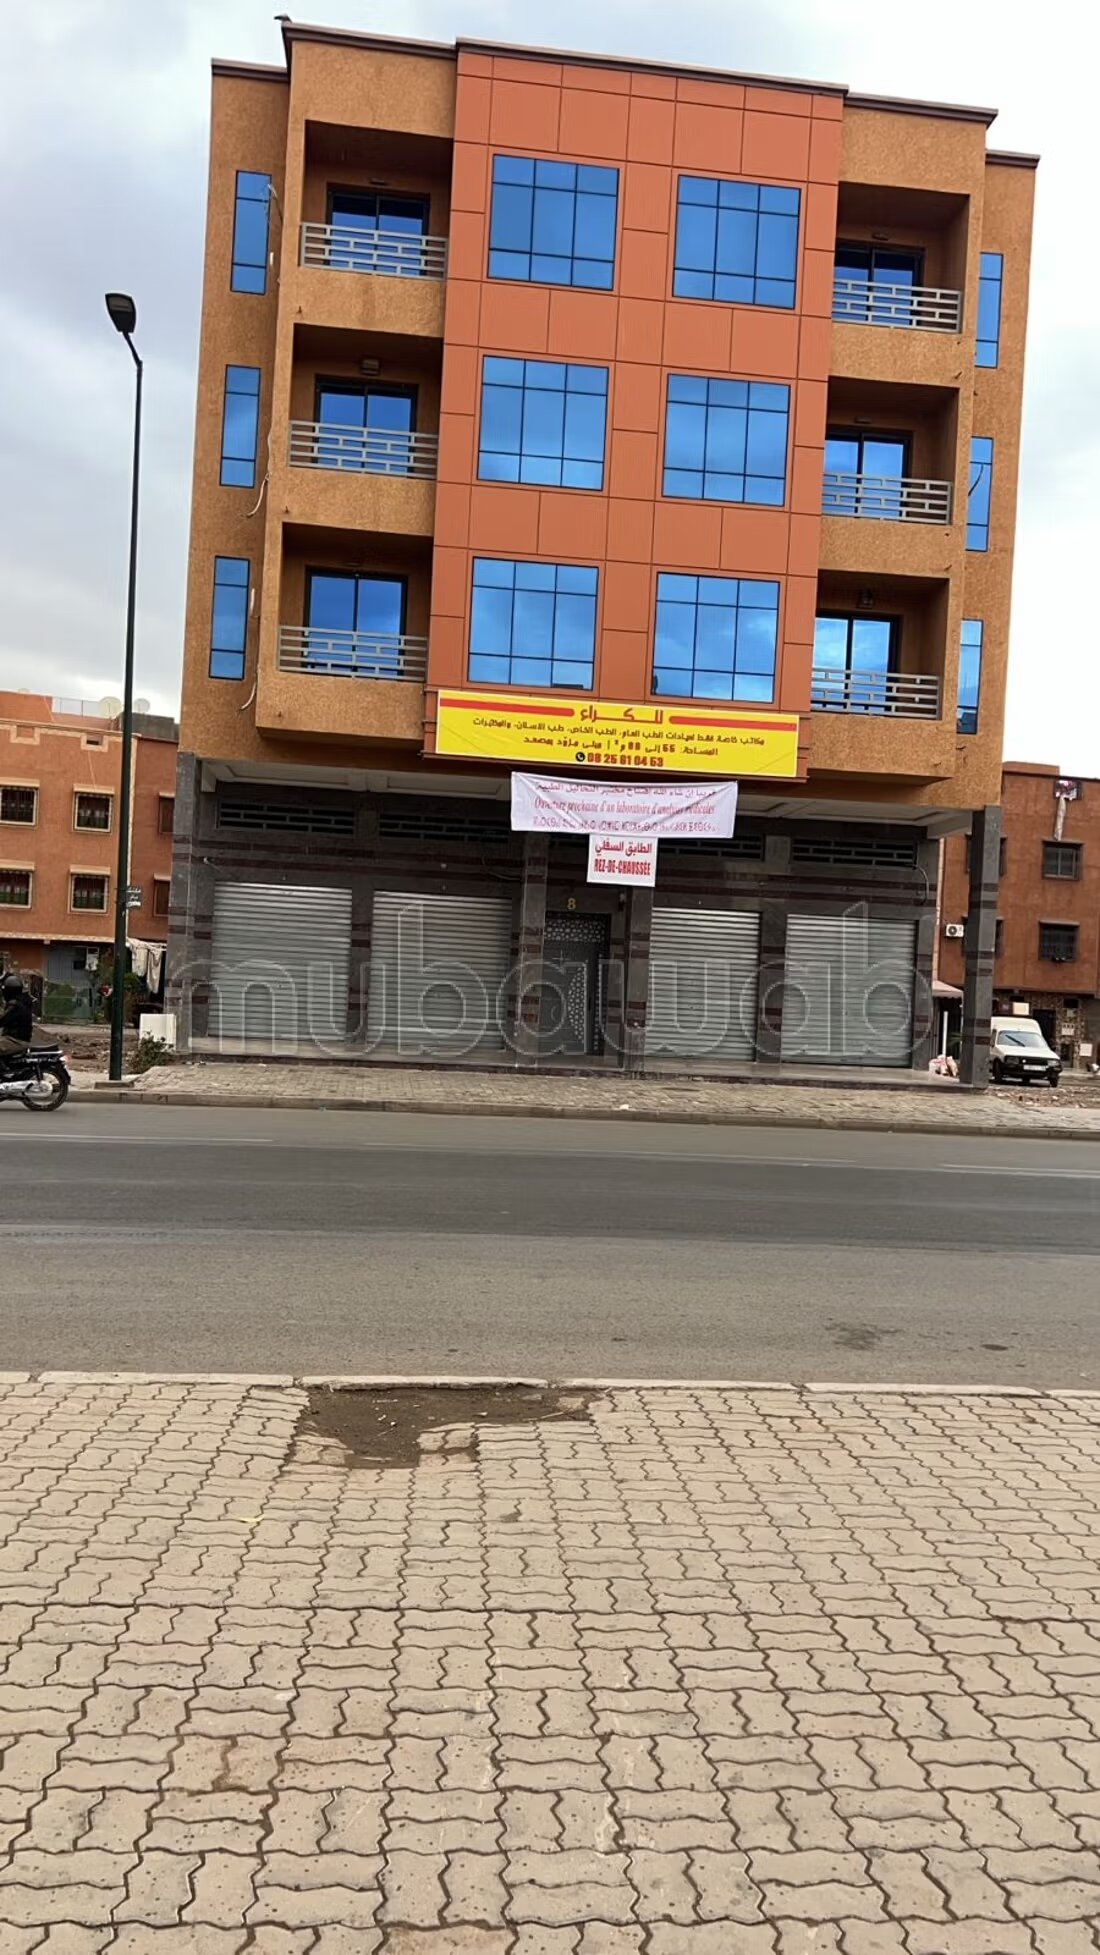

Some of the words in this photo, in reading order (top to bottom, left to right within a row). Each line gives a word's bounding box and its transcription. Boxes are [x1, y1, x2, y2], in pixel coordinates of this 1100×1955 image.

[580, 705, 663, 724] للكراء
[547, 723, 565, 732] طب
[595, 727, 617, 736] الطب
[642, 729, 664, 739] الطب
[595, 837, 624, 856] السفلي
[625, 842, 652, 857] الطابق
[594, 858, 651, 876] REZ-DE-CHAUSSÉE
[566, 898, 577, 910] 8
